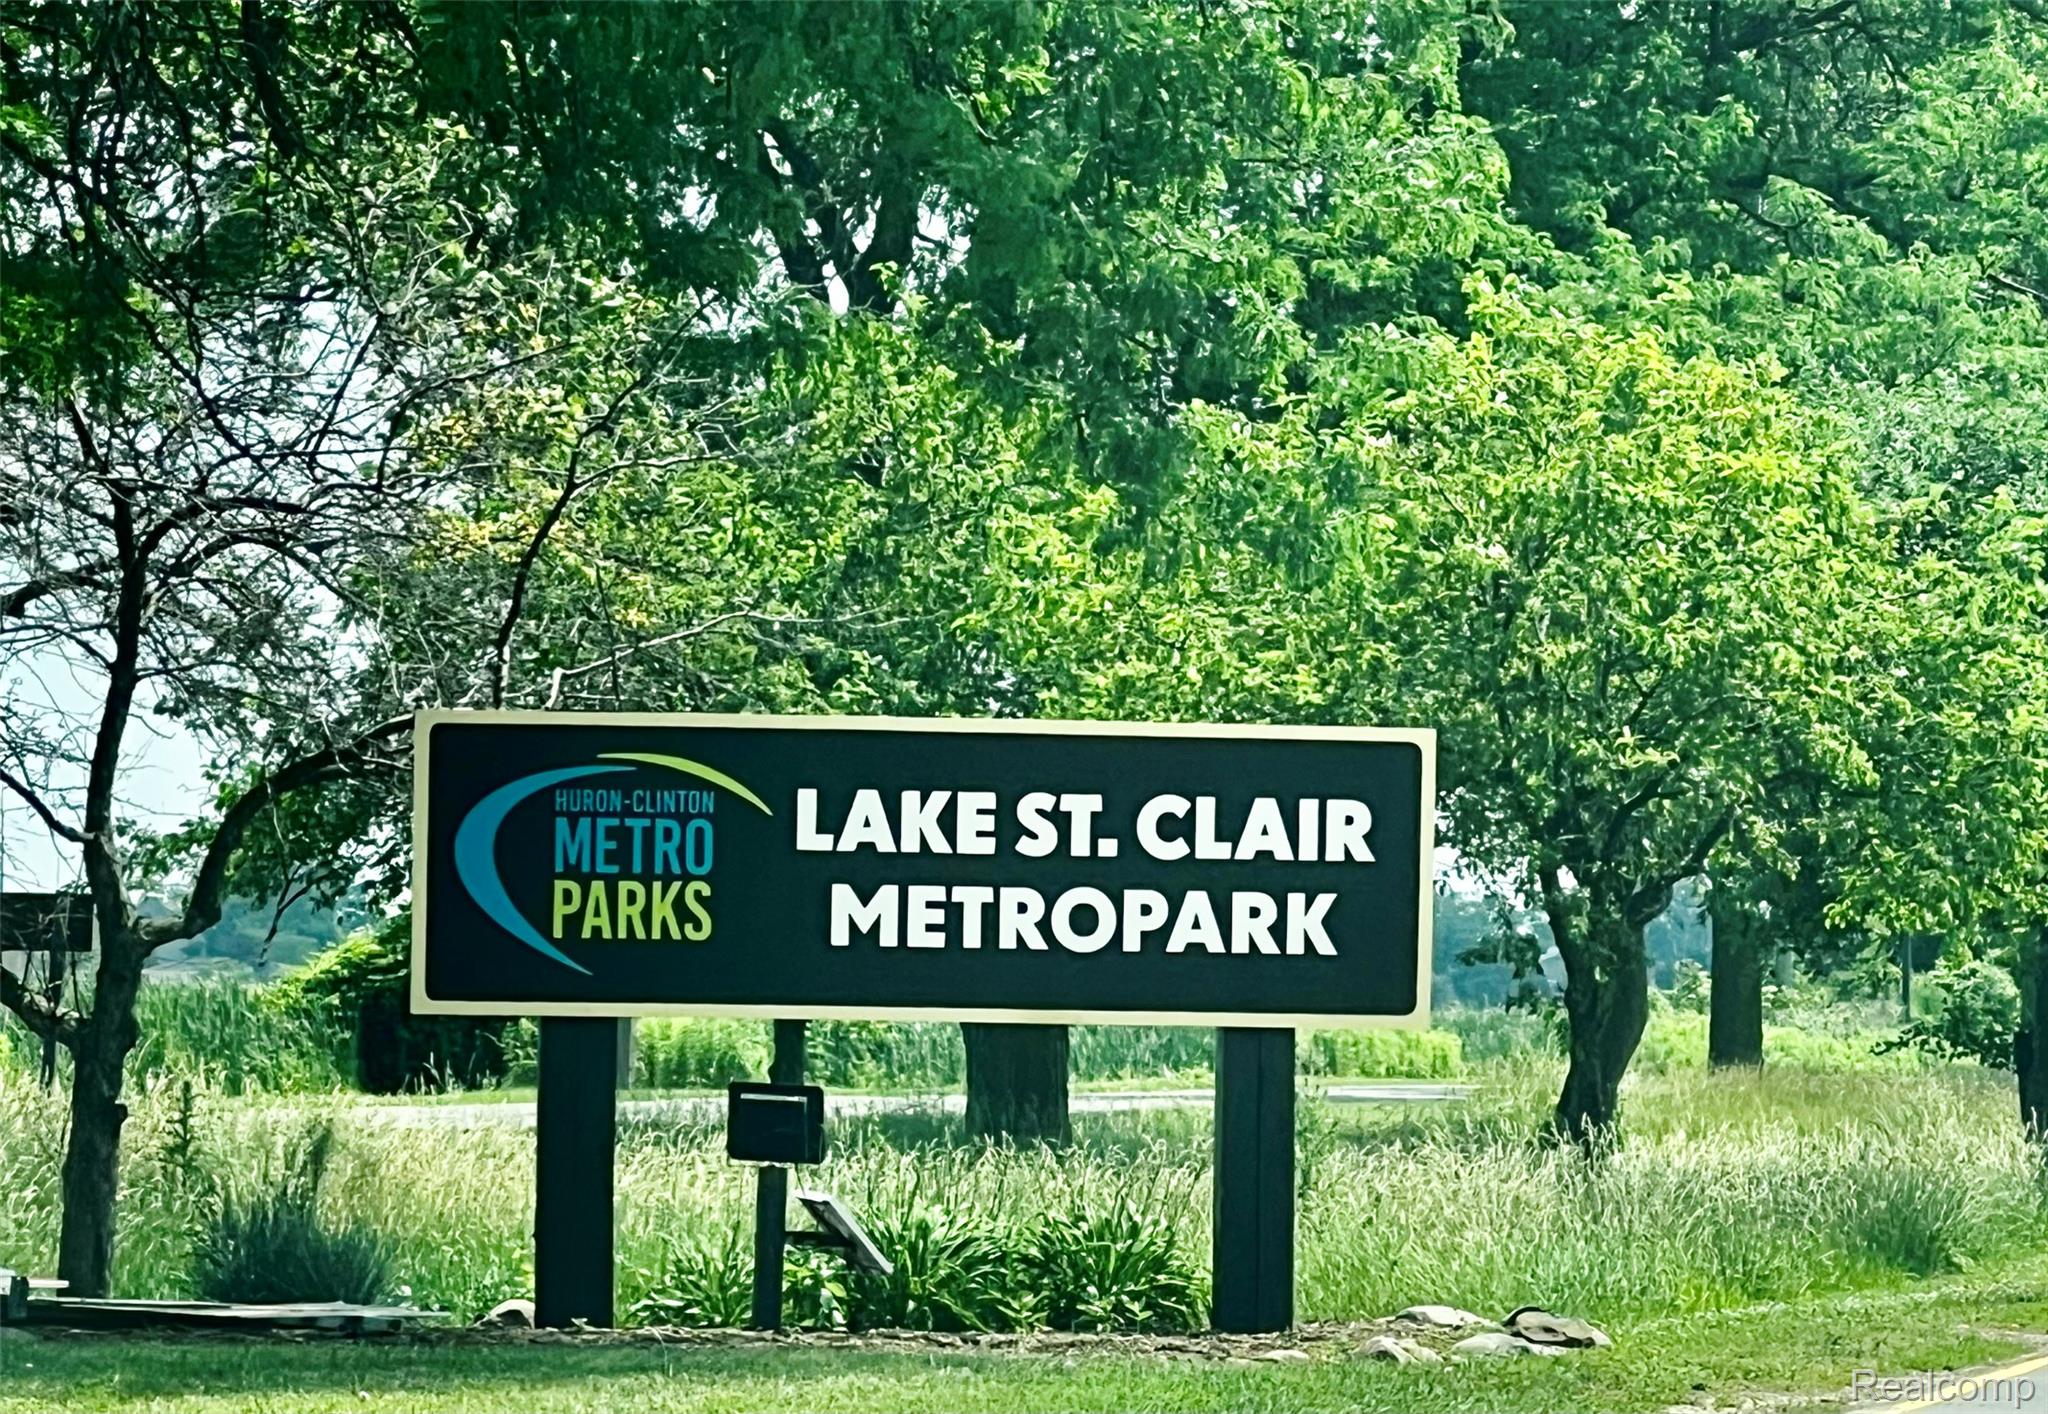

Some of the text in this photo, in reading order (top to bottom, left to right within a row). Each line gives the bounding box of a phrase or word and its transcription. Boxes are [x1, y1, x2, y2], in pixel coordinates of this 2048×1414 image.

[554, 789, 715, 814] HURON-CLINTON
[796, 788, 1376, 863] LAKE ST. CLAIR
[554, 816, 714, 876] METRO
[552, 879, 713, 941] PARKS
[830, 883, 1338, 956] METROPARK
